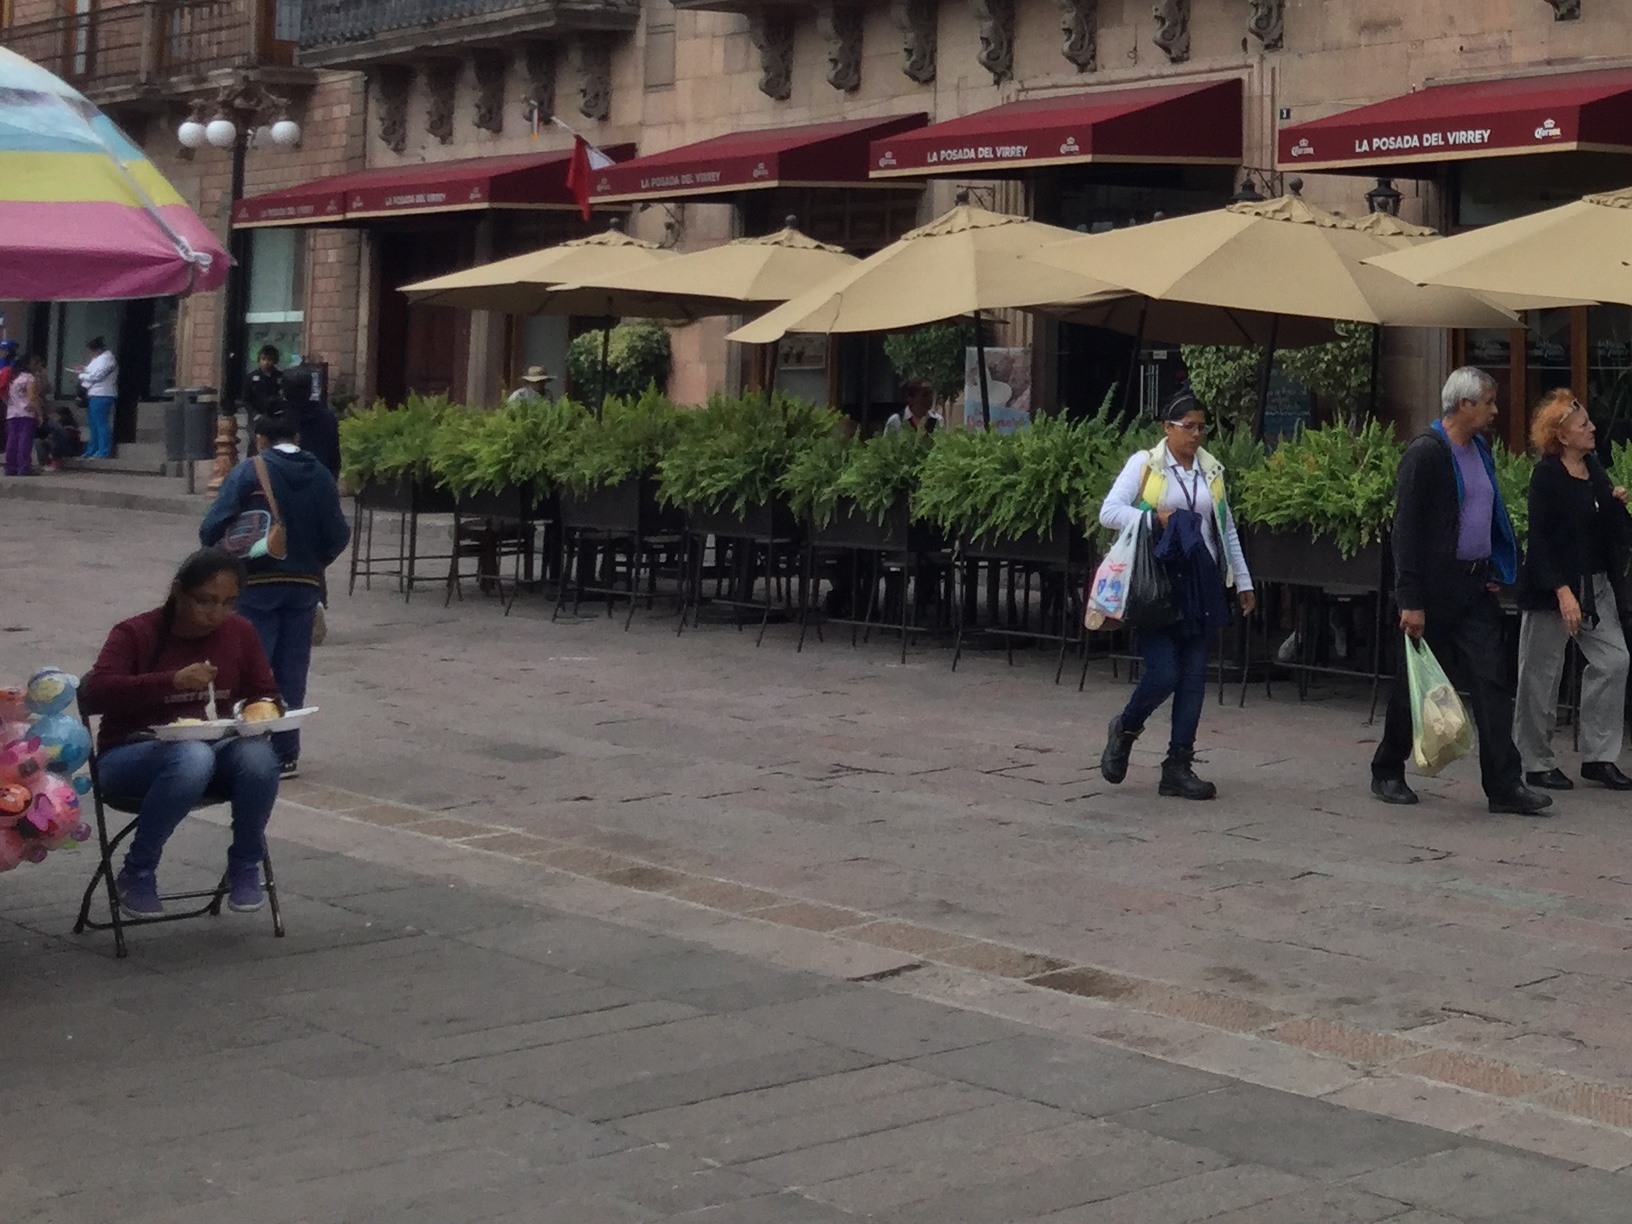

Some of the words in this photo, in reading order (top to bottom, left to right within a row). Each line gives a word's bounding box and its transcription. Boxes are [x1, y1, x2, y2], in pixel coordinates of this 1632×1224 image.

[1355, 139, 1370, 153] LA
[1372, 134, 1420, 151] POSADA
[1422, 132, 1445, 147] DEL
[1447, 129, 1491, 146] VIRREY
[926, 151, 938, 163] LA
[940, 147, 976, 162] POSADA
[977, 146, 994, 159] DEL
[995, 145, 1029, 158] VIRREY
